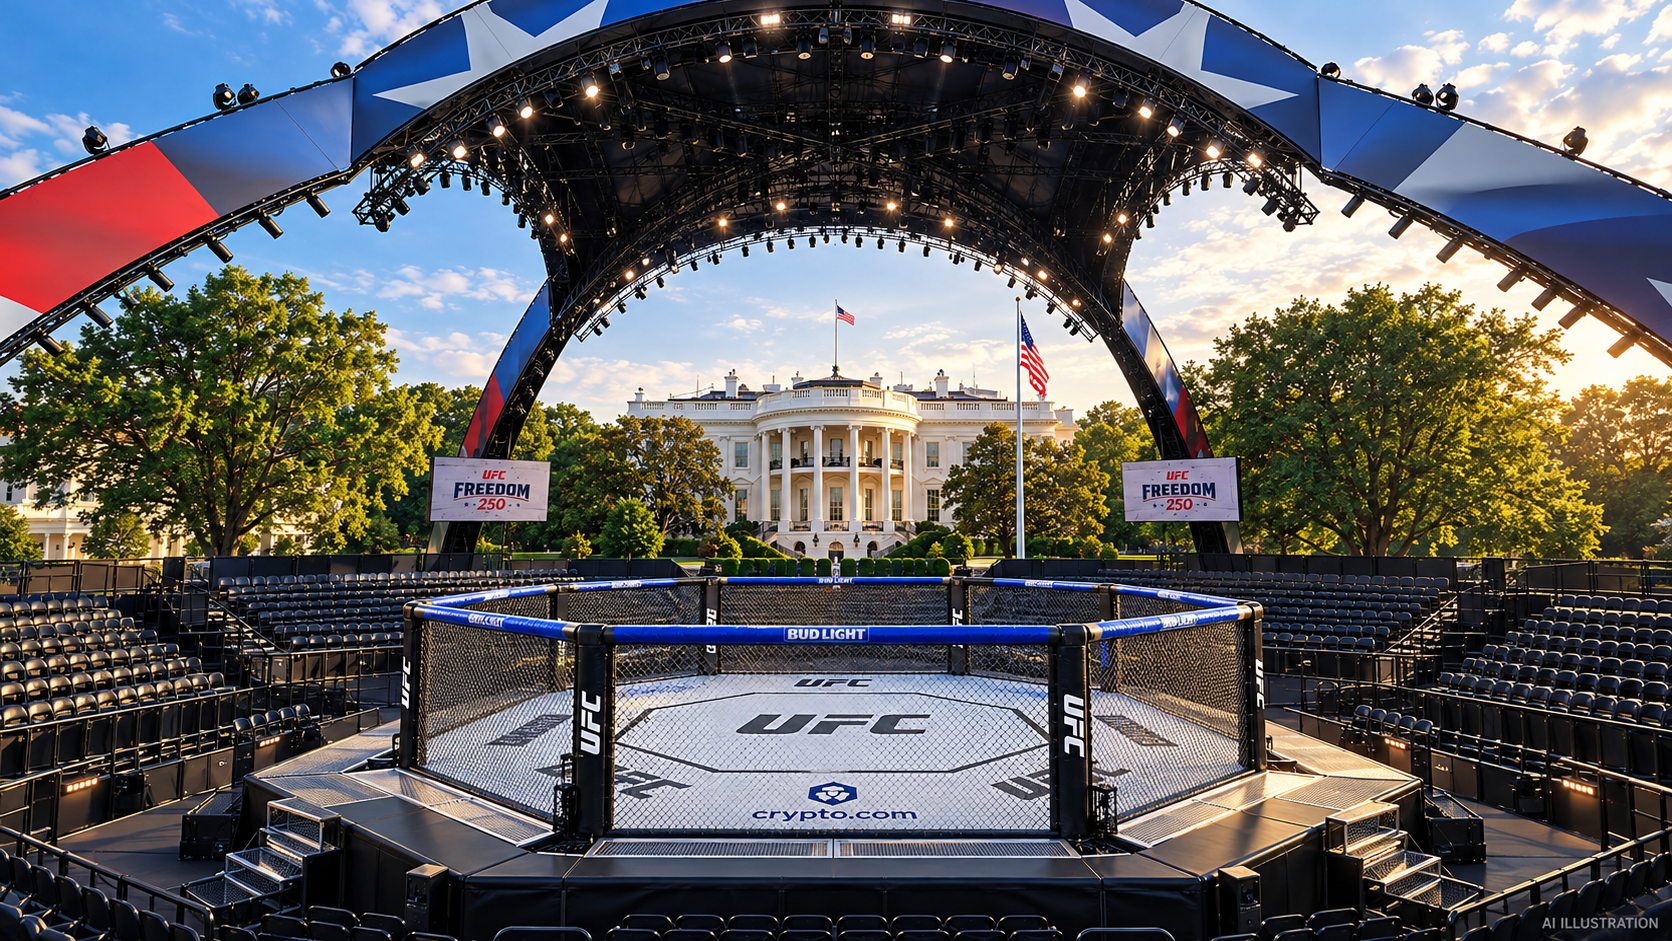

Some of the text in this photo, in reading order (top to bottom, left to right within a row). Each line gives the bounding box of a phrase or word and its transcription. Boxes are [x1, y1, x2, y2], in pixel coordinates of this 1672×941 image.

[482, 470, 506, 480] UFC
[1166, 470, 1189, 480] UFC
[453, 482, 530, 499] FREEDOM
[1142, 482, 1216, 500] FREEDOM
[477, 498, 506, 510] 250
[1166, 498, 1193, 511] 250
[787, 628, 866, 640] BUD LIGHT
[401, 656, 411, 710] UFC
[794, 678, 873, 687] UFC
[1255, 658, 1265, 710] UFC
[580, 690, 601, 756] UFC
[736, 714, 931, 735] UFC
[1063, 693, 1085, 759] UFC
[752, 808, 918, 822] crypto.com
